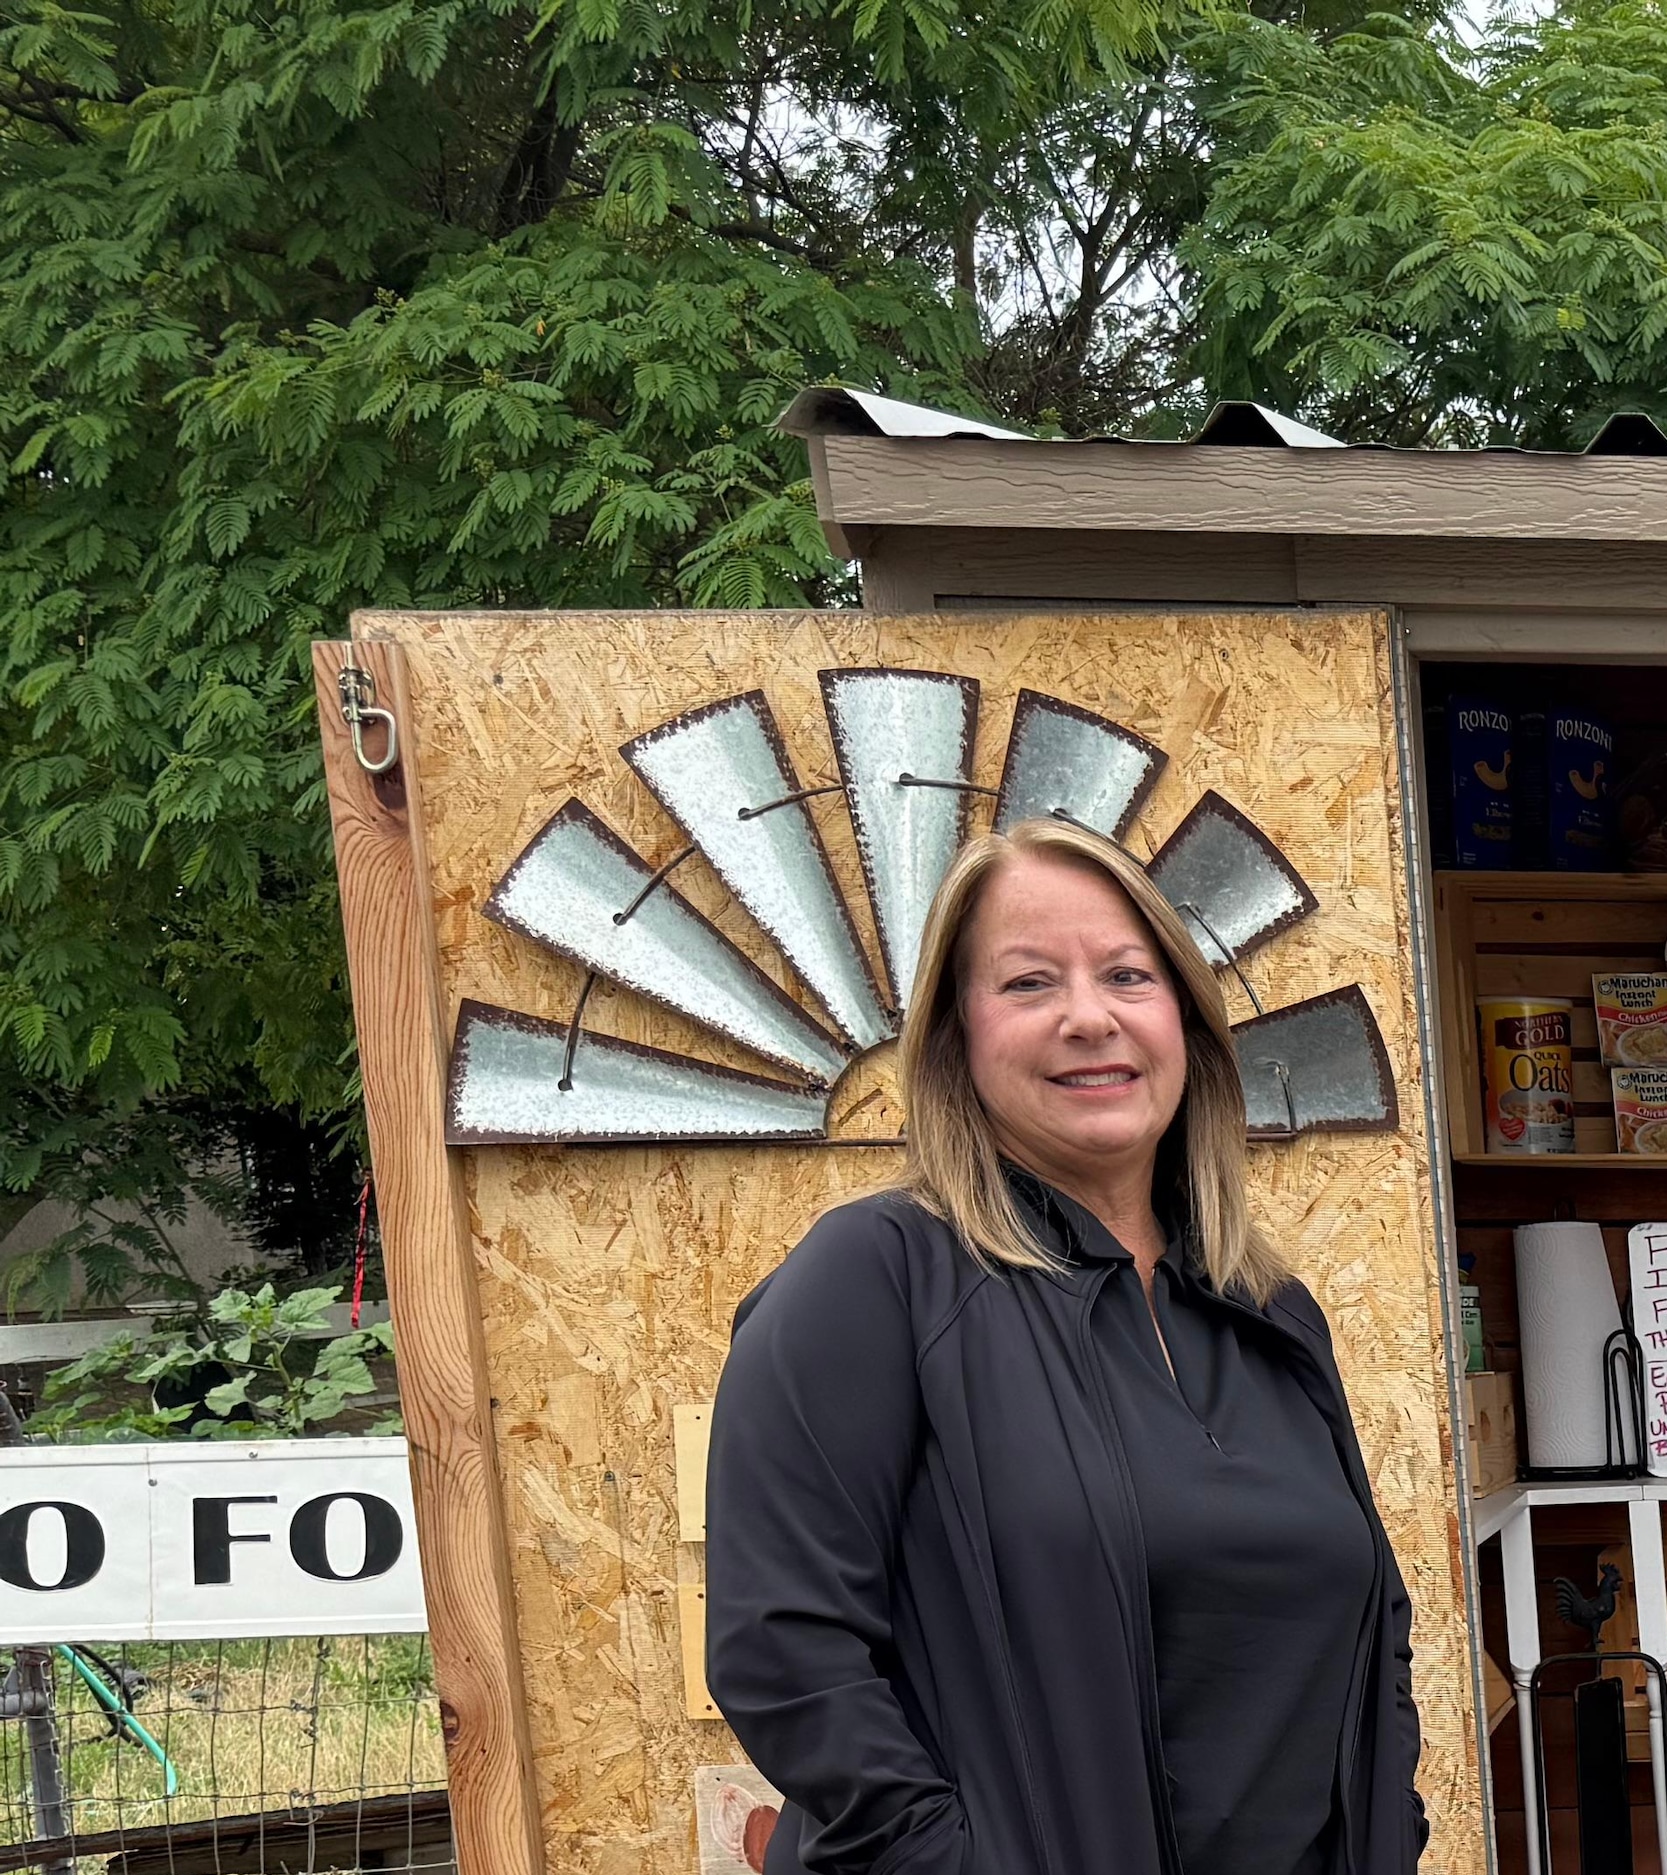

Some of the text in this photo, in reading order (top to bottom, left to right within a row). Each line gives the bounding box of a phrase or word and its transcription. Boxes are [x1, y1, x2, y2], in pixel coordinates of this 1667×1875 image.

[1458, 710, 1511, 733] RONZO
[1556, 720, 1612, 753] RONZONI
[1614, 990, 1656, 999] Instant
[1620, 999, 1653, 1008] Lunch
[1617, 1010, 1657, 1021] Chicken
[1515, 1024, 1565, 1046] GOLD
[1509, 1054, 1570, 1093] Oats
[0, 1501, 105, 1591] O
